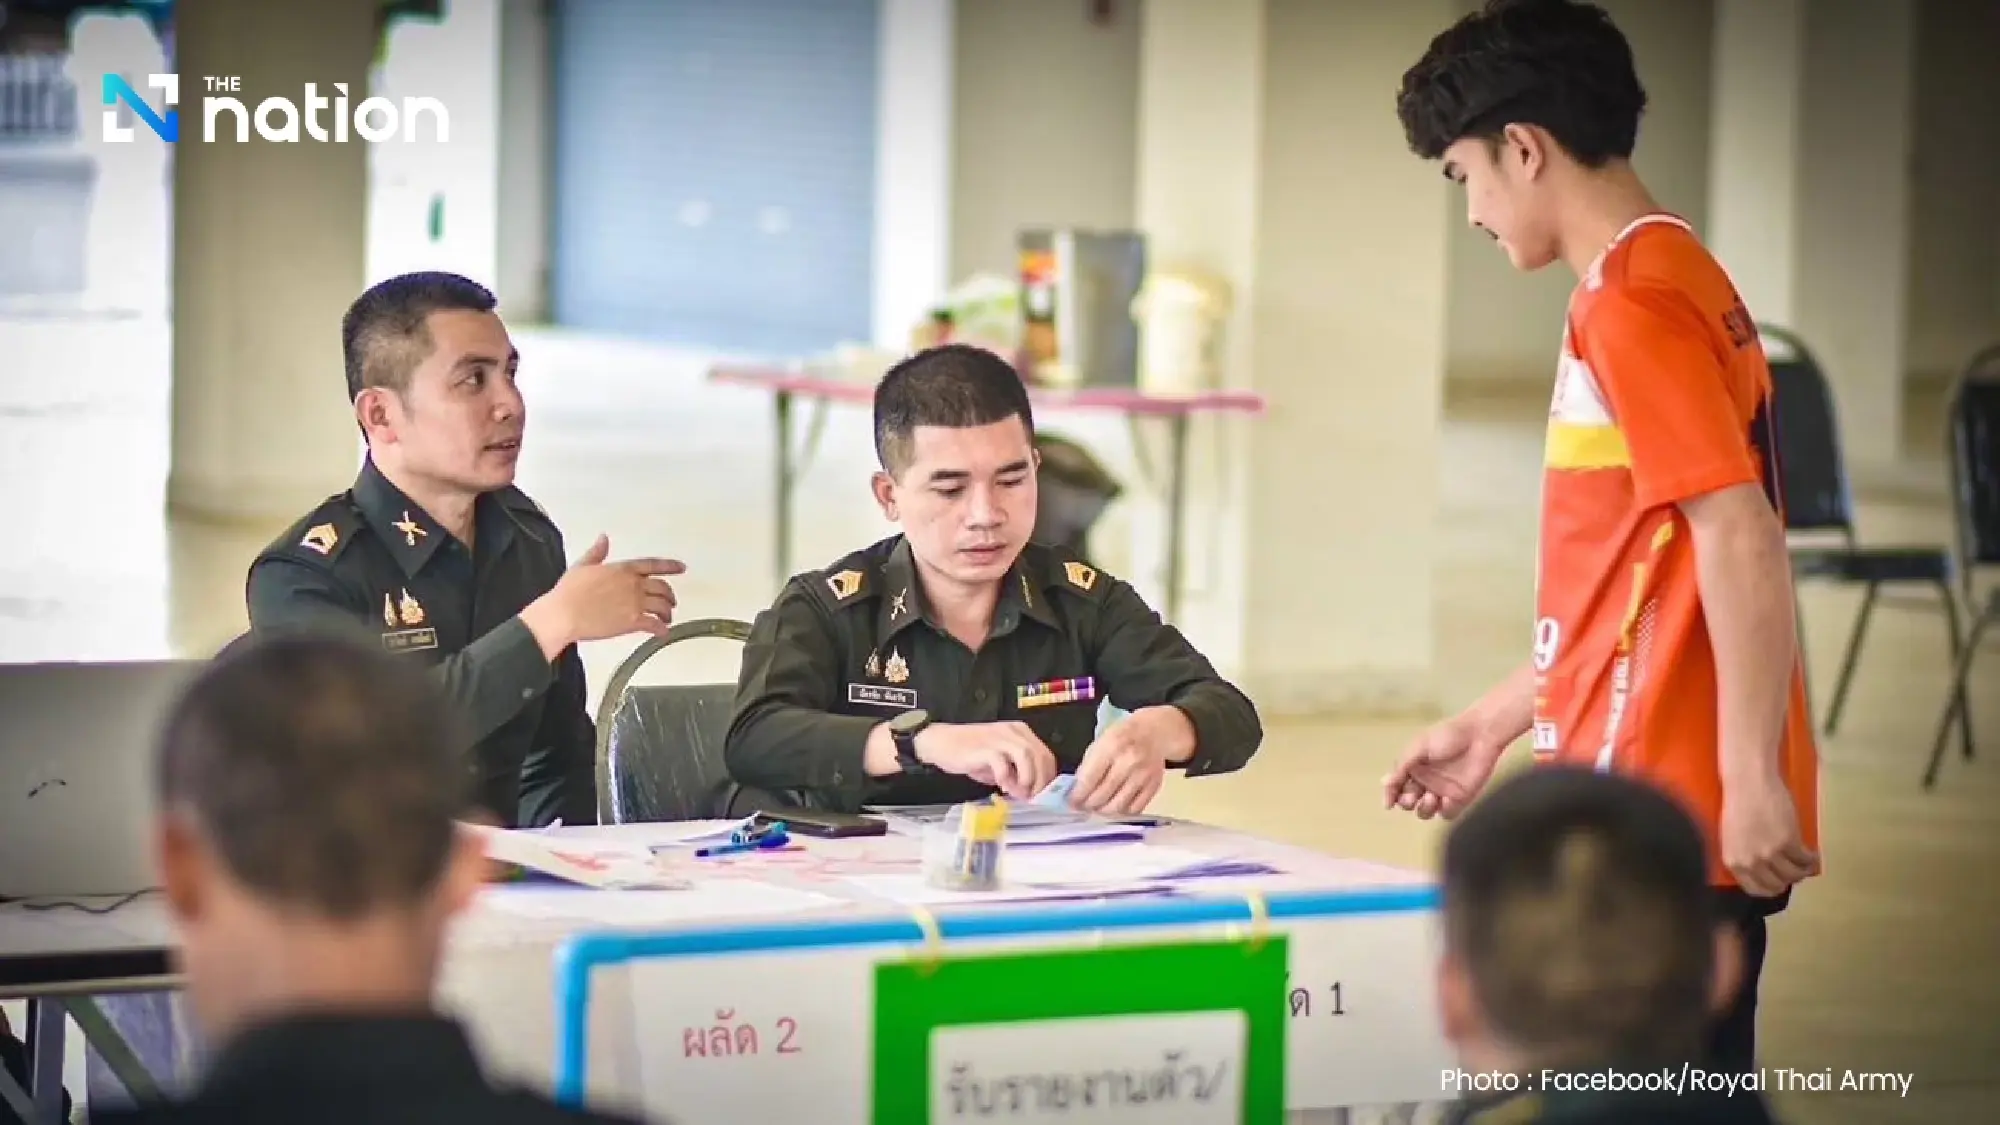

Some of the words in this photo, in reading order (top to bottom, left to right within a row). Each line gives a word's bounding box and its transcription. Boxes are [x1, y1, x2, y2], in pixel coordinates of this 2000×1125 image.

[1330, 980, 1345, 1016] 1
[683, 1007, 758, 1058] ผลัด
[775, 1016, 802, 1053] 2
